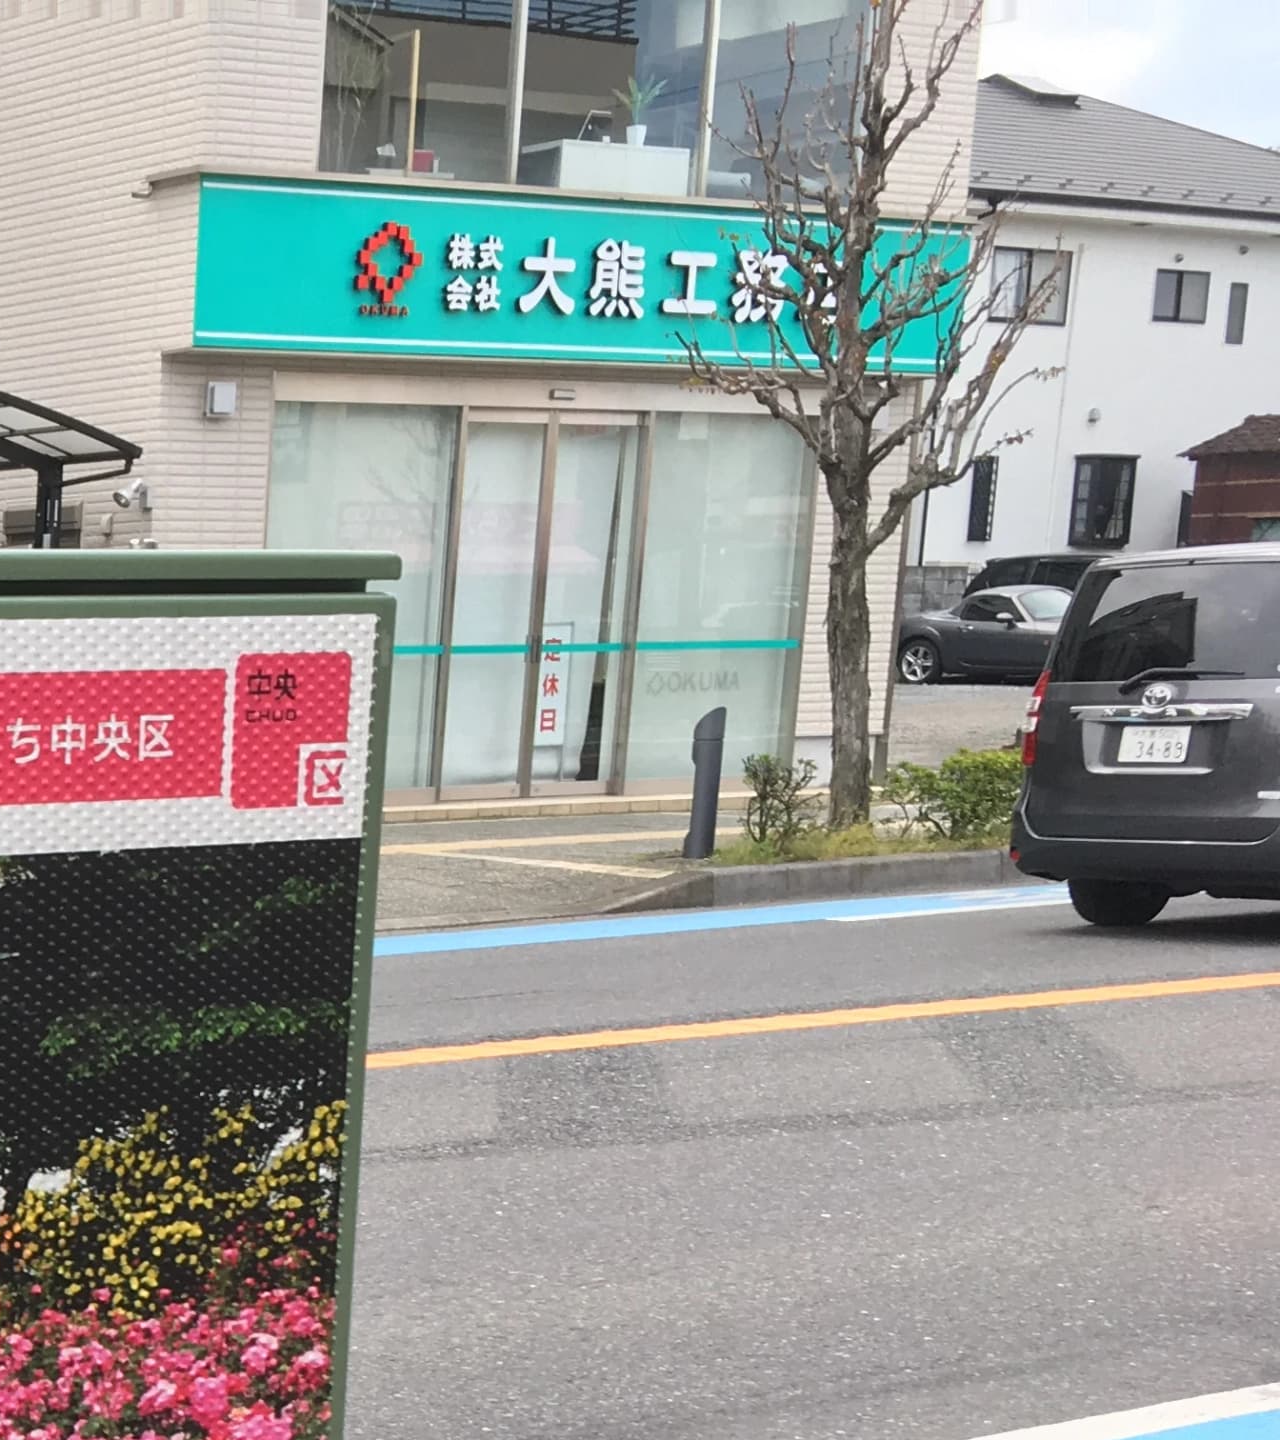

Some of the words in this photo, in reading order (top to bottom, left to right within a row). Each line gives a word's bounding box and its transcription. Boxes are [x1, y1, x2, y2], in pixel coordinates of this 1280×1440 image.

[246, 669, 298, 701] 中央
[245, 709, 298, 723] CHUO
[304, 750, 348, 806] 区
